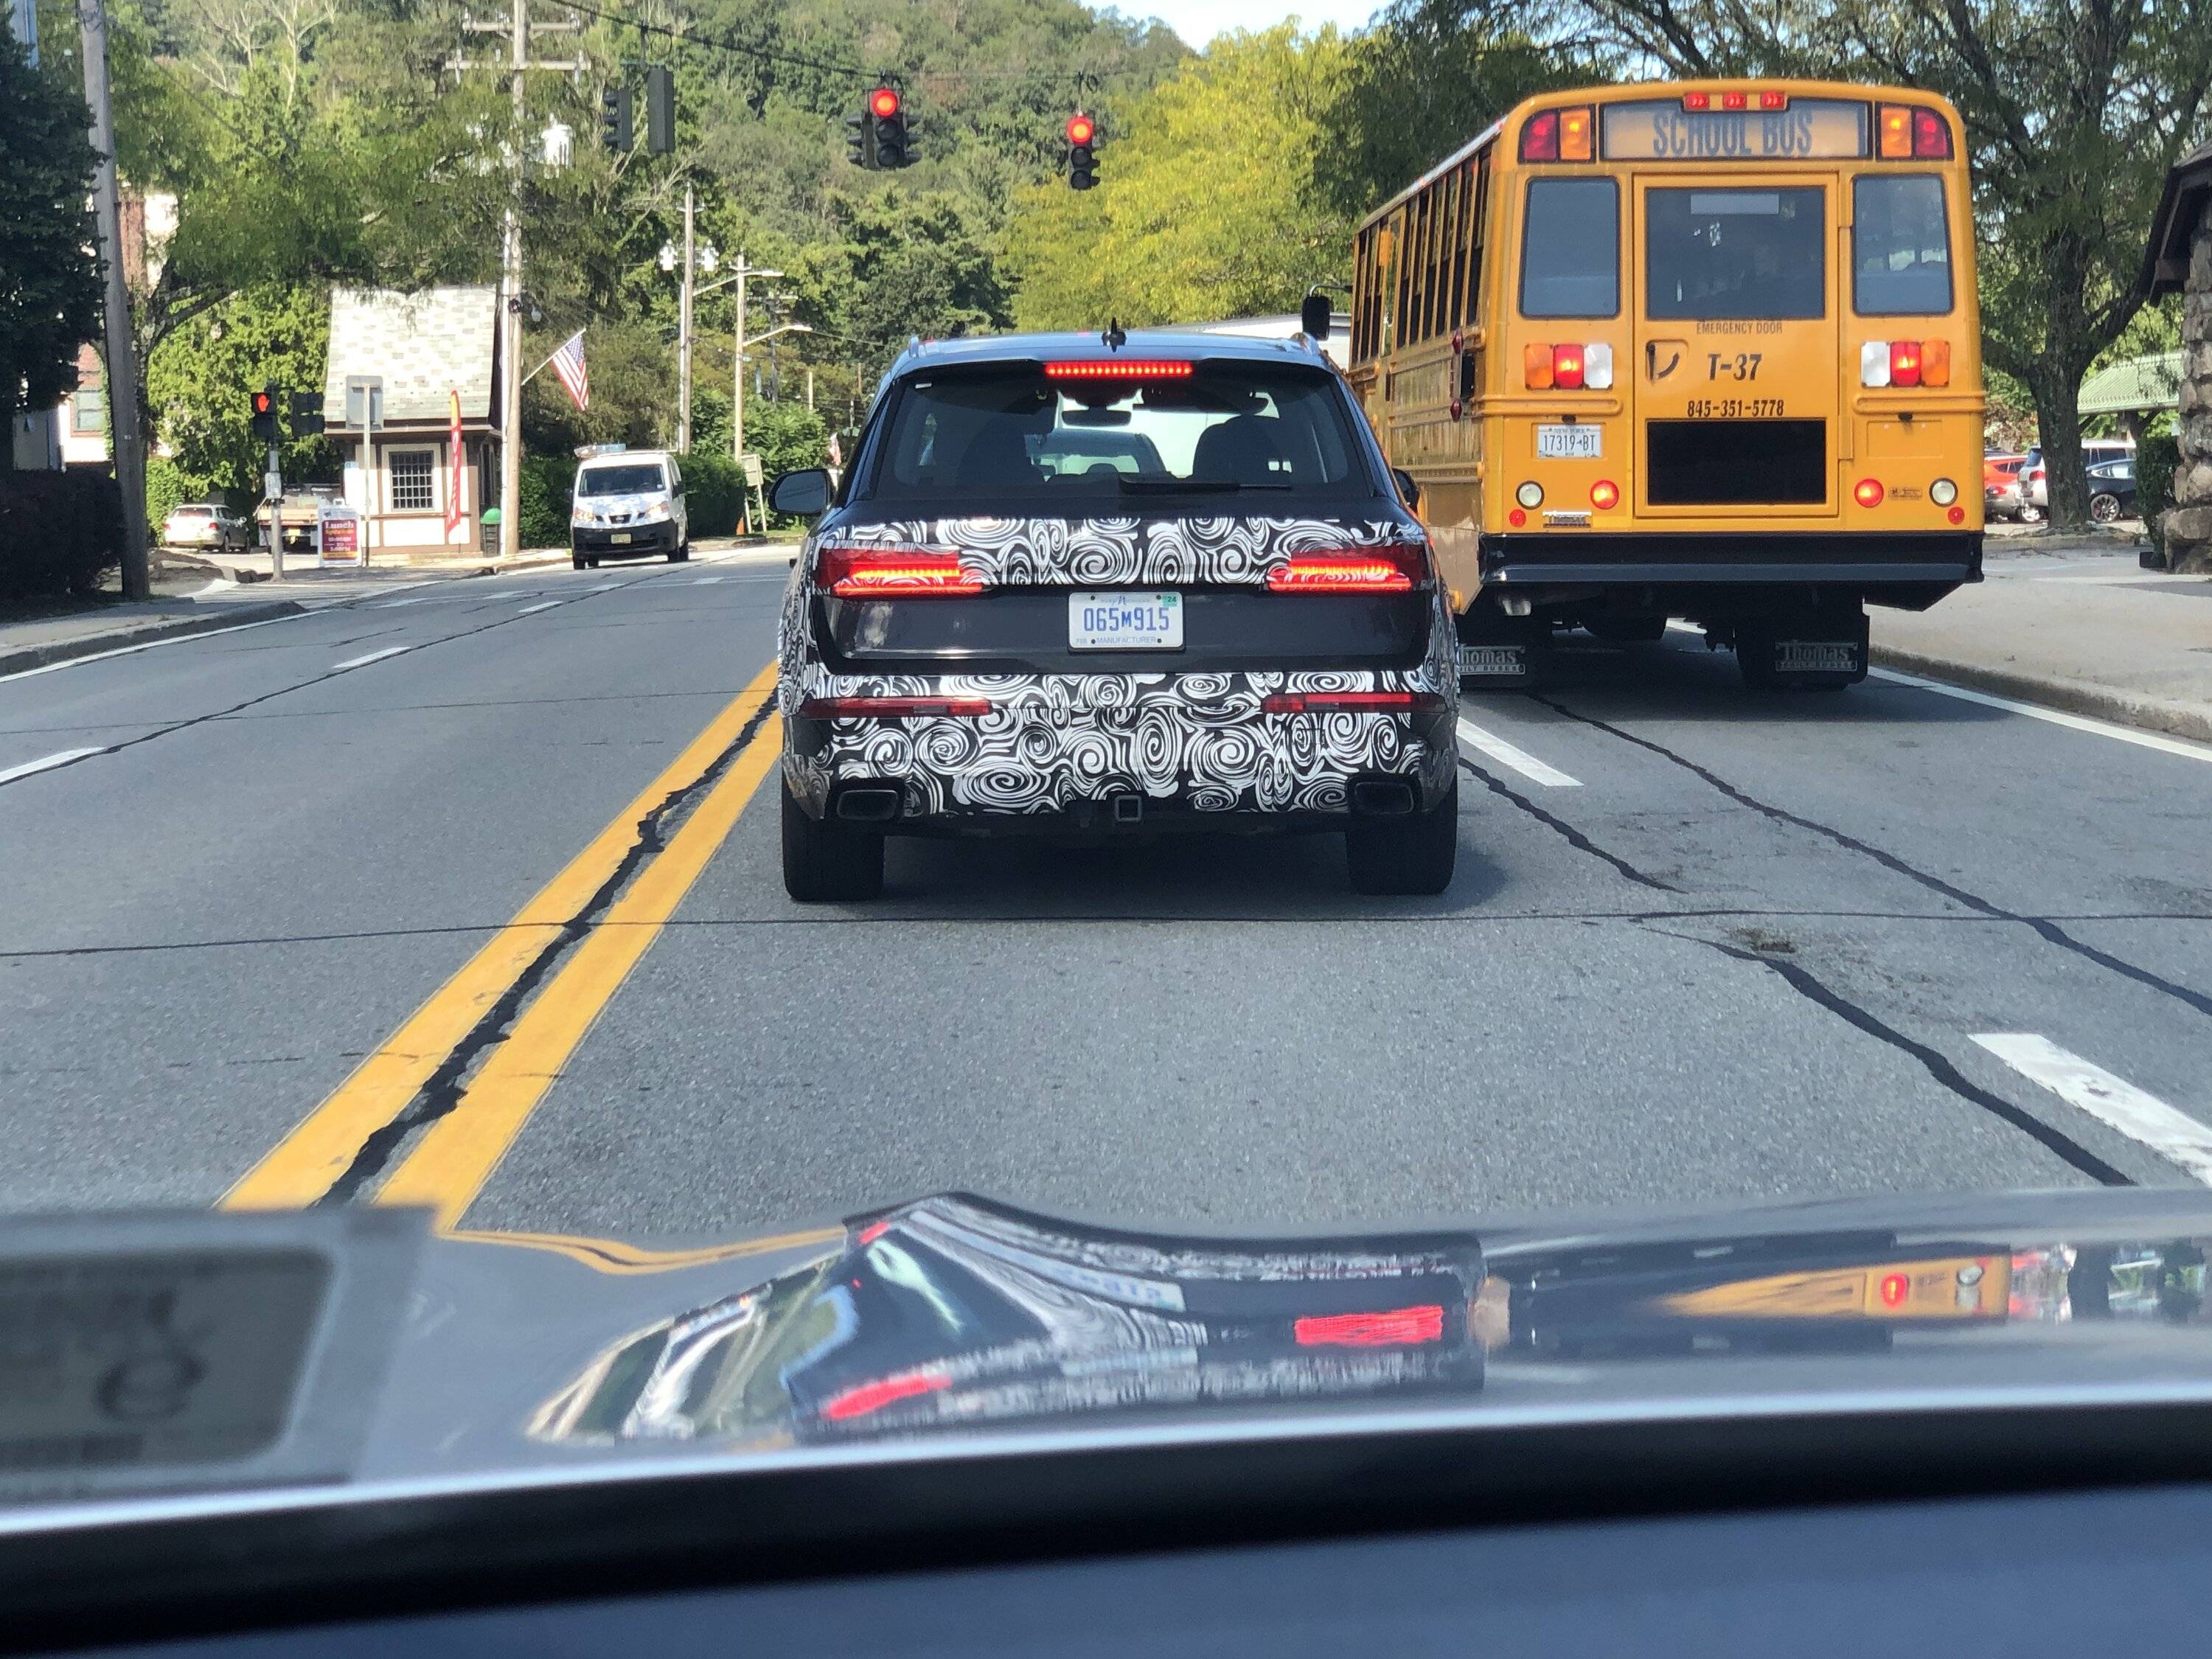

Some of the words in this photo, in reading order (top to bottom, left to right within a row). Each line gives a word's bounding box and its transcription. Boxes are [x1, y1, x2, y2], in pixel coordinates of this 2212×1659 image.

[1653, 111, 1752, 156] SCHOOL
[1762, 111, 1812, 156] BUS
[1697, 322, 1753, 334] EMERGENCY
[1756, 321, 1783, 333] DOOR
[1707, 353, 1762, 380] T-37
[1687, 400, 1784, 417] 845-351-5778
[325, 521, 354, 529] Lunch
[1084, 607, 1169, 632] 065M915
[1096, 636, 1156, 644] MANUFACTURER
